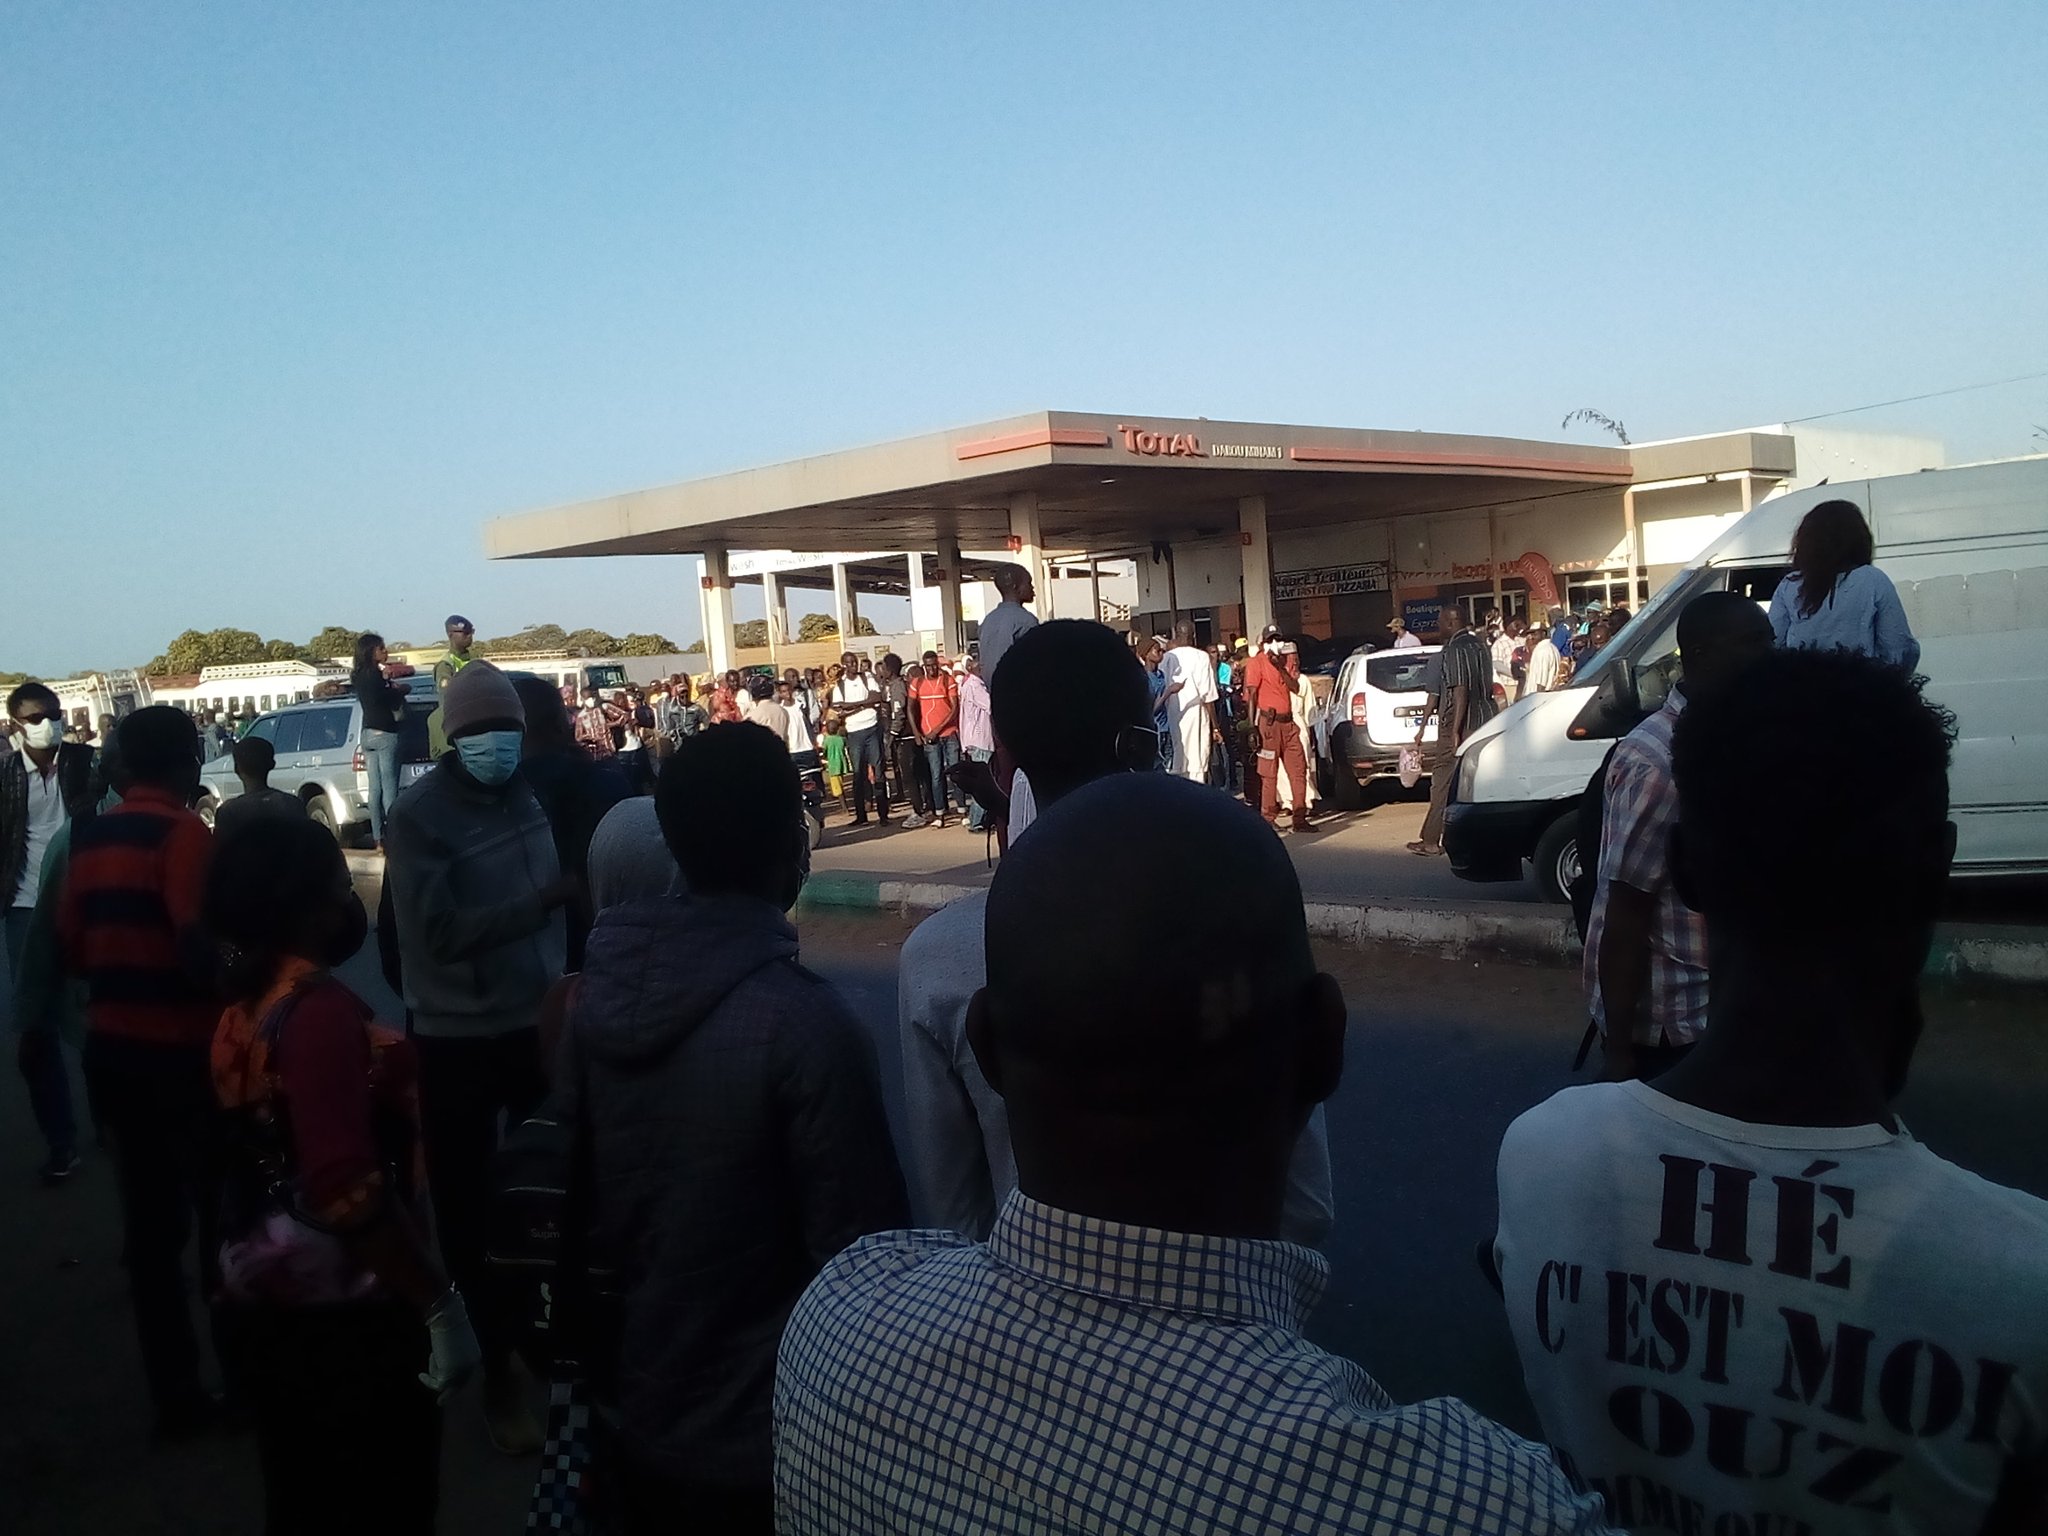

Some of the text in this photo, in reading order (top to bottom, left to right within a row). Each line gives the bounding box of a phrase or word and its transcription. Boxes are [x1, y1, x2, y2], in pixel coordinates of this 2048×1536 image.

[1117, 424, 1207, 458] TOTAL
[1653, 1153, 1855, 1290] HÉ
[1772, 1306, 2019, 1444] MOI
